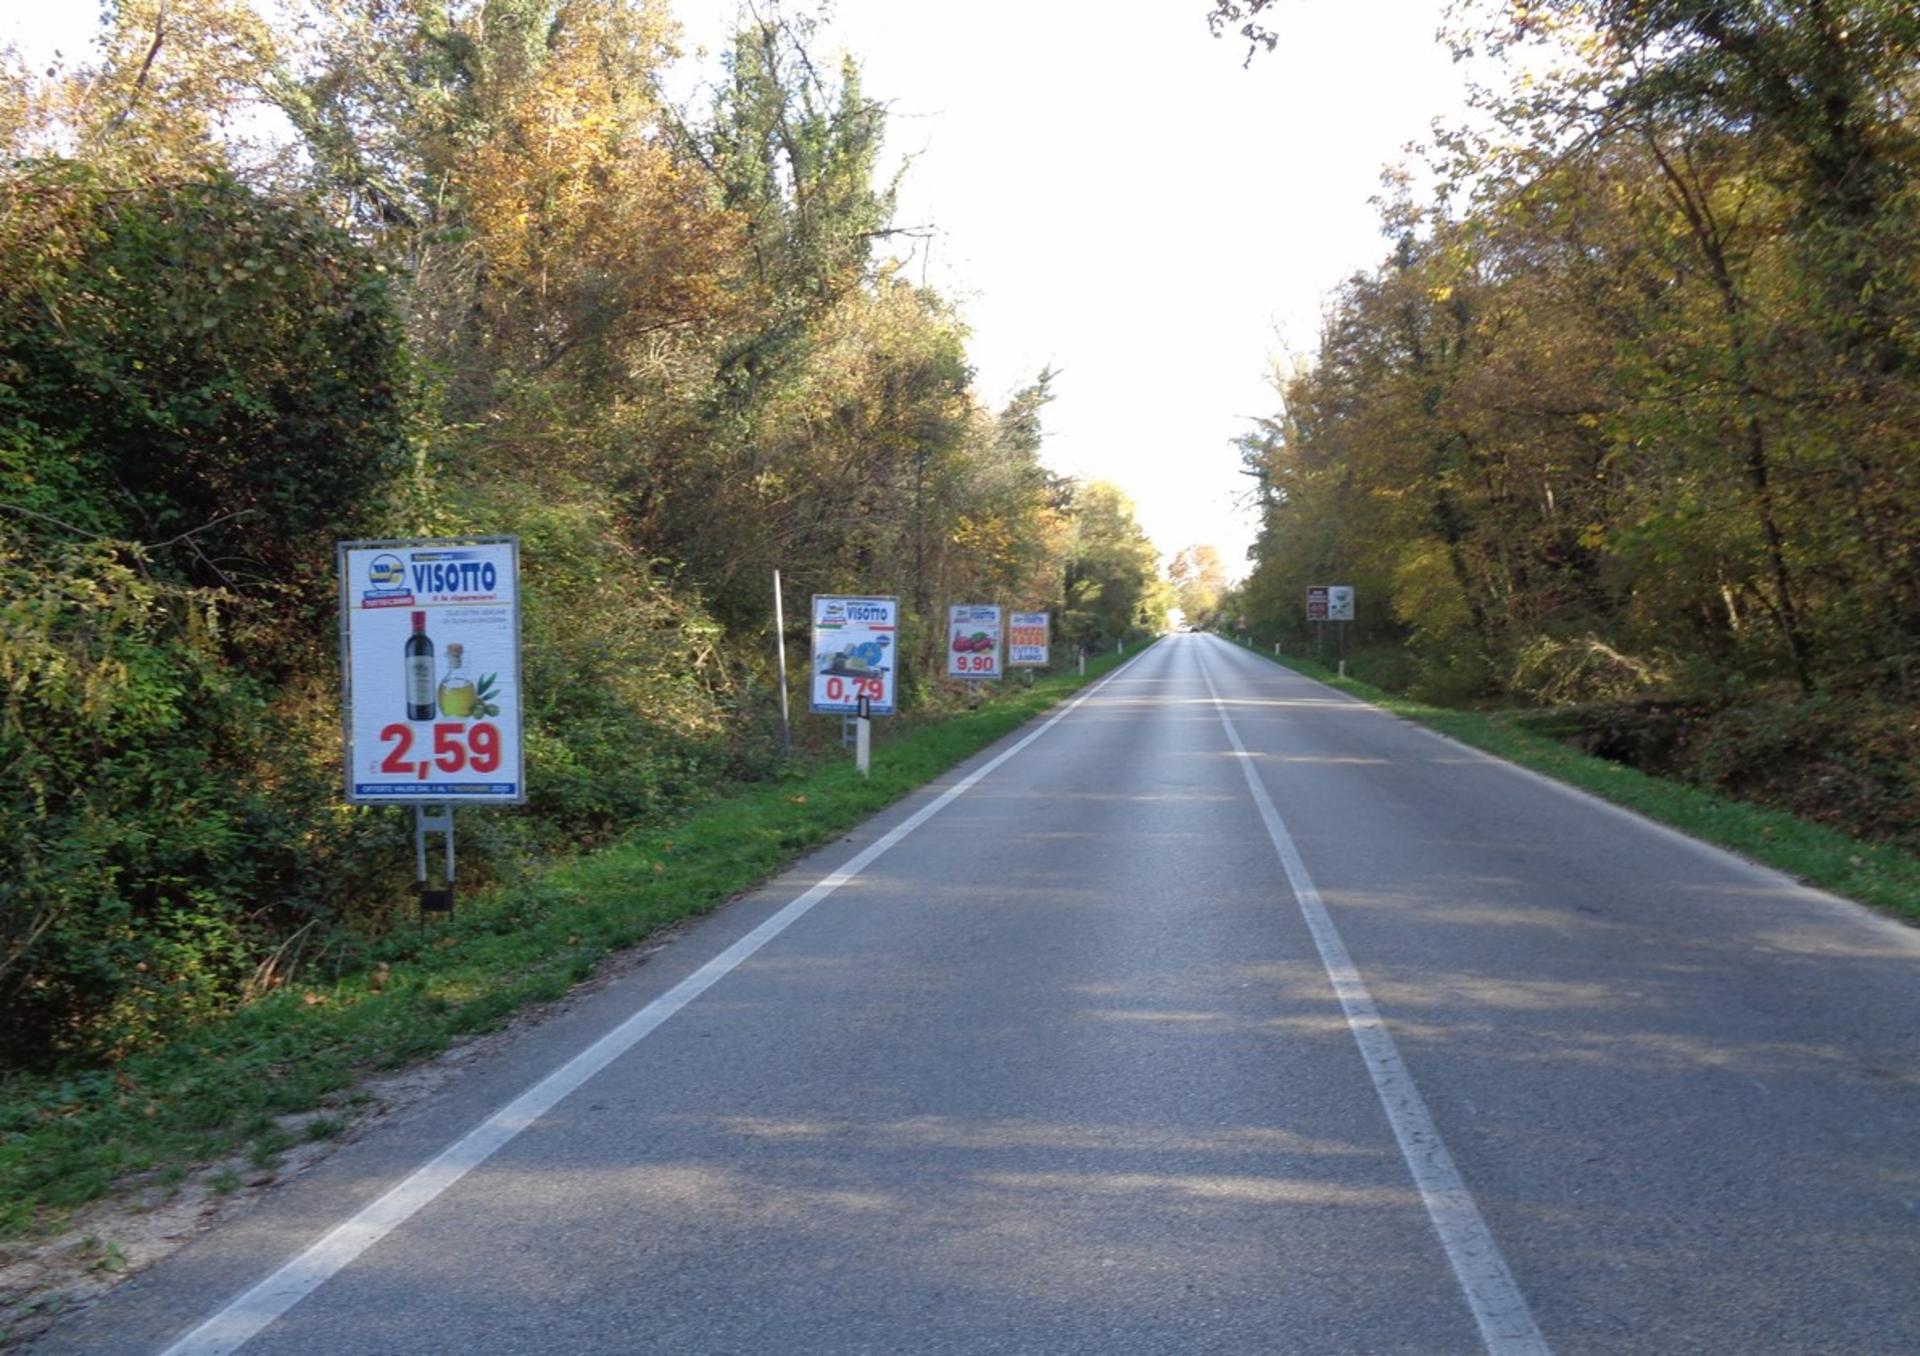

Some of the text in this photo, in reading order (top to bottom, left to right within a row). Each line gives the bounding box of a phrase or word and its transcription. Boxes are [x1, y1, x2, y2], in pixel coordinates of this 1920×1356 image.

[412, 562, 496, 593] VISOTTO
[846, 606, 888, 621] VISOTTO
[957, 656, 994, 672] 9,90
[826, 677, 885, 704] 0,79
[380, 723, 502, 780] 2,59
